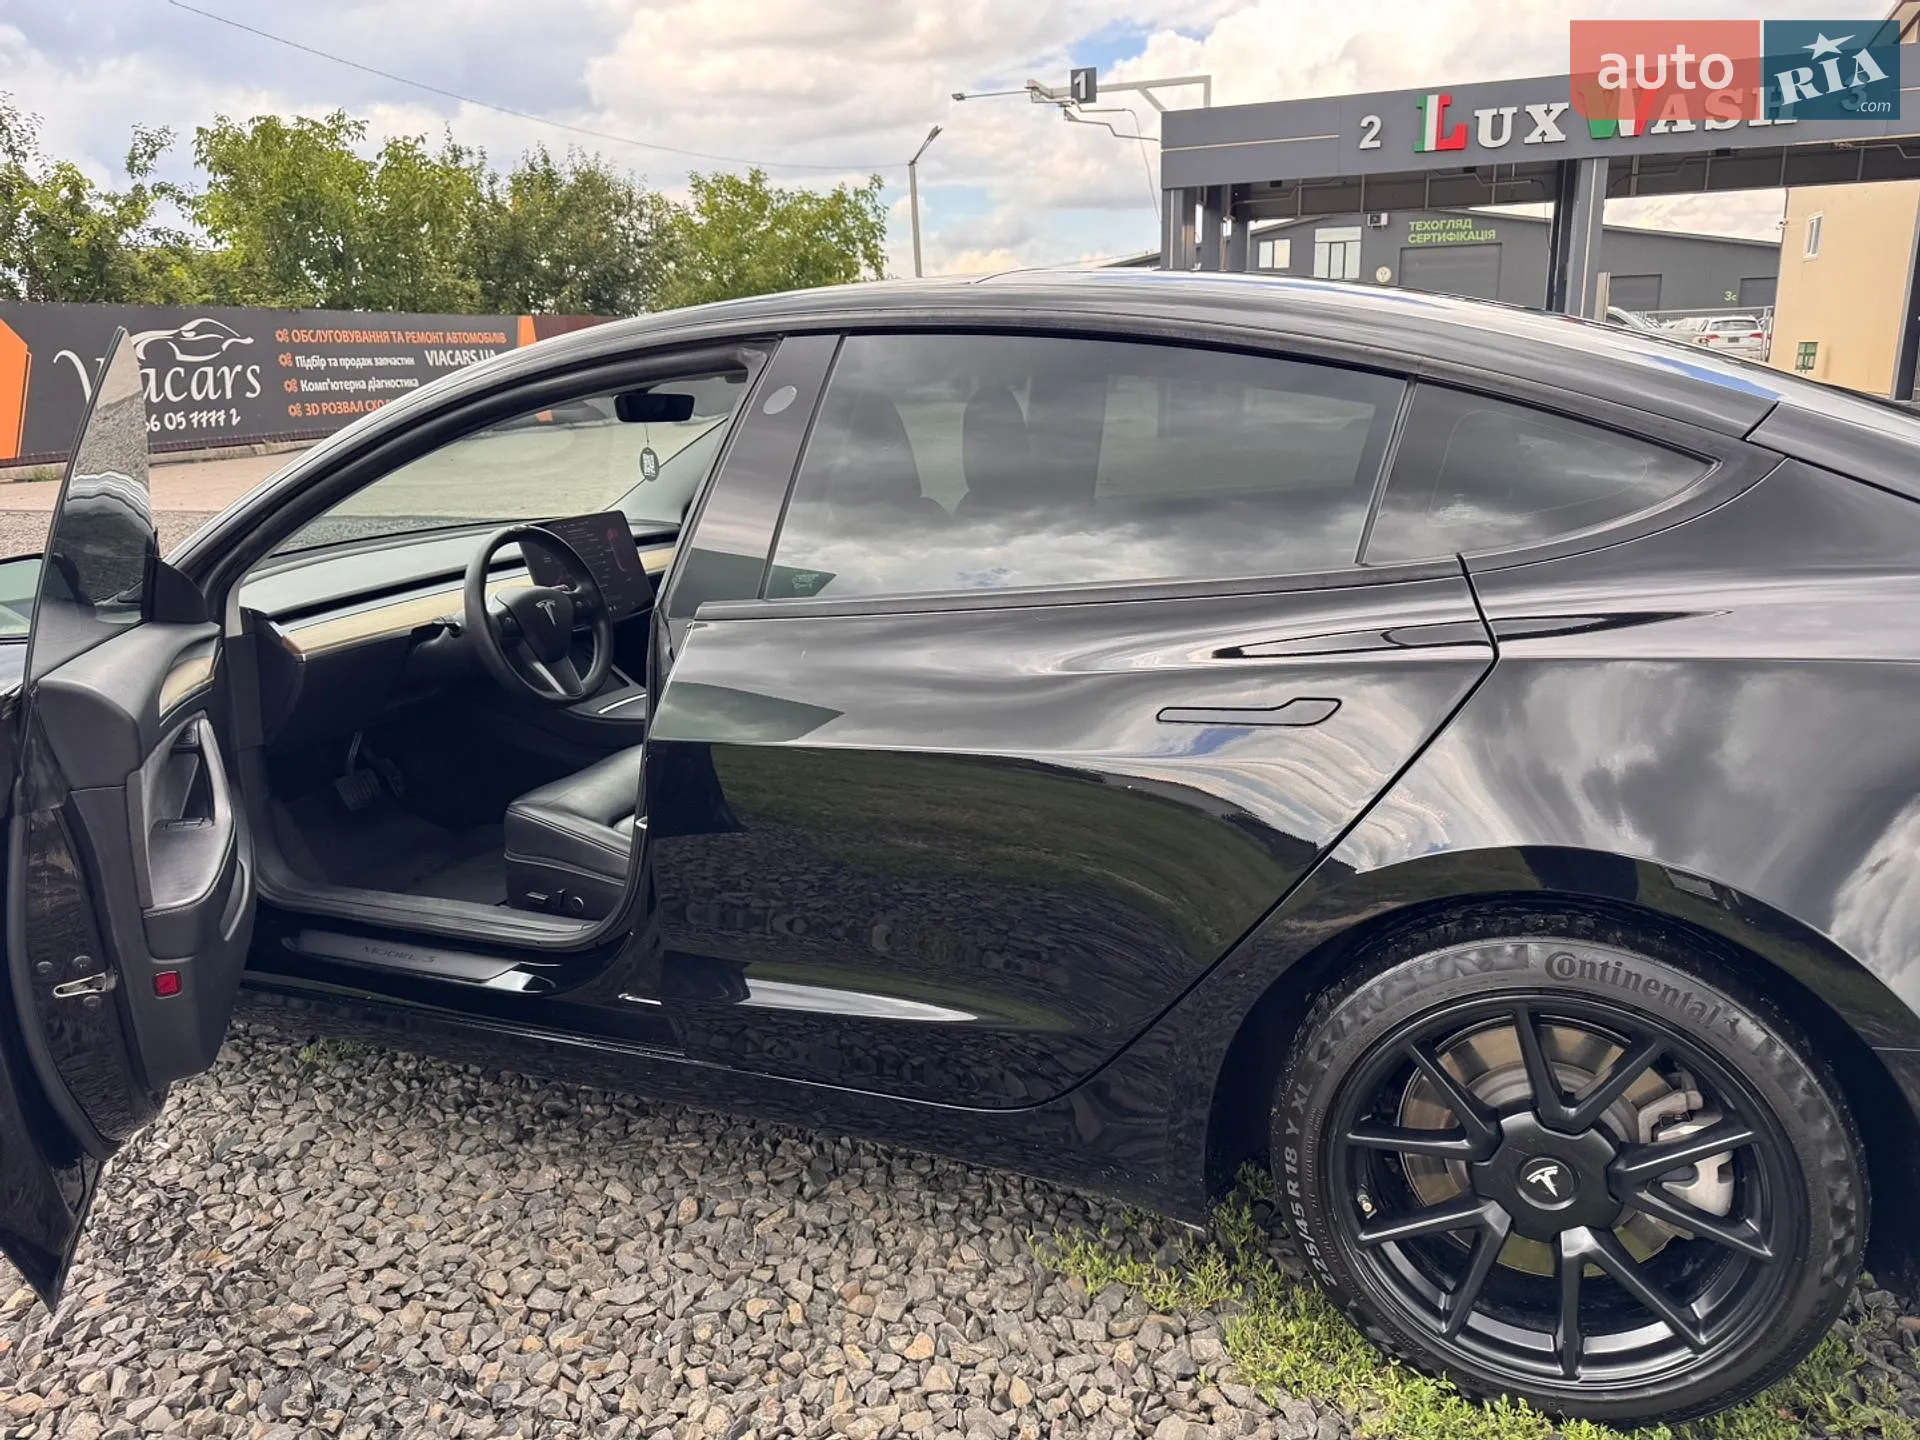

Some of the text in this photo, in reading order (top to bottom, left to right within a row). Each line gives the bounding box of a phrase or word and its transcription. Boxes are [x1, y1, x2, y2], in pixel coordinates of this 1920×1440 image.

[1074, 71, 1087, 99] 1
[1359, 115, 1382, 150] 2
[1408, 218, 1472, 231] ТЕХОГЛЯД
[1408, 229, 1496, 243] СЕРТИФІКАЦІЯ
[291, 329, 507, 344] ОБСЛУГОВУВАННЯ ТА РЕМОНТ АВТОМОБІЛІВ
[295, 355, 415, 370] Підбір та продаж запчастин
[425, 350, 496, 367] VIACARSUA
[53, 349, 262, 404] Vacars
[368, 376, 419, 392] діагностика
[305, 403, 319, 416] 3D
[322, 401, 365, 415] РОЗВАЛ
[145, 413, 161, 432] 6
[164, 411, 186, 430] 05
[189, 409, 226, 428] 7777
[1545, 951, 1724, 1029] Continental
[1291, 1083, 1313, 1115] XL
[1290, 1201, 1338, 1288] 225/45
